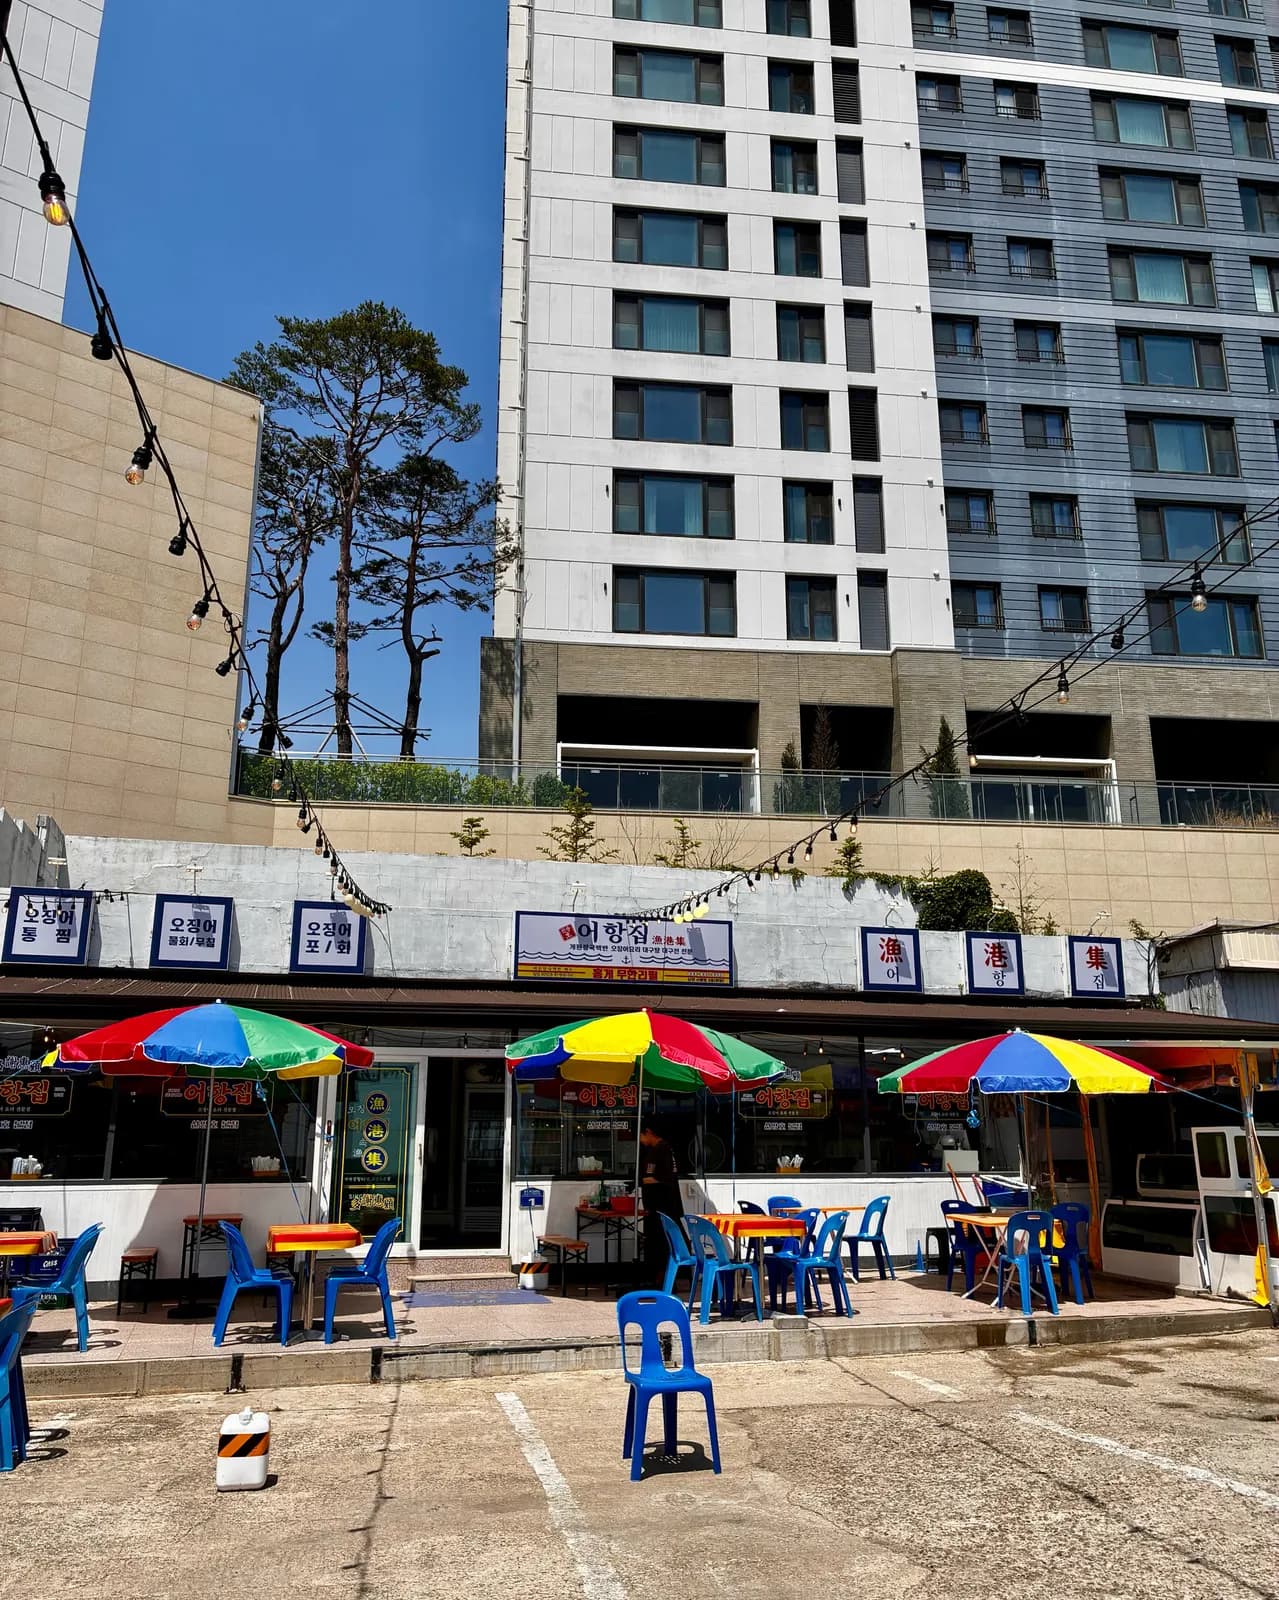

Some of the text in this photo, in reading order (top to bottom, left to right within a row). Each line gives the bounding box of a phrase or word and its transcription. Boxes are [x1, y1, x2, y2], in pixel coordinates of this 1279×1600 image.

[24, 906, 75, 926] 오징어
[169, 916, 217, 934] 오징어
[21, 926, 72, 945] 통 찜
[306, 921, 352, 938] 오징어
[577, 920, 649, 945] 어항집
[879, 936, 903, 963] 漁
[984, 941, 1008, 968] 港
[1085, 945, 1108, 970] 集
[617, 968, 659, 982] 무한리필
[886, 965, 901, 983] 어
[991, 970, 1007, 987] 항
[1092, 974, 1105, 990] 집
[184, 1080, 253, 1106] 어항집
[578, 1085, 638, 1108] 어항집
[755, 1087, 811, 1109] 어항집
